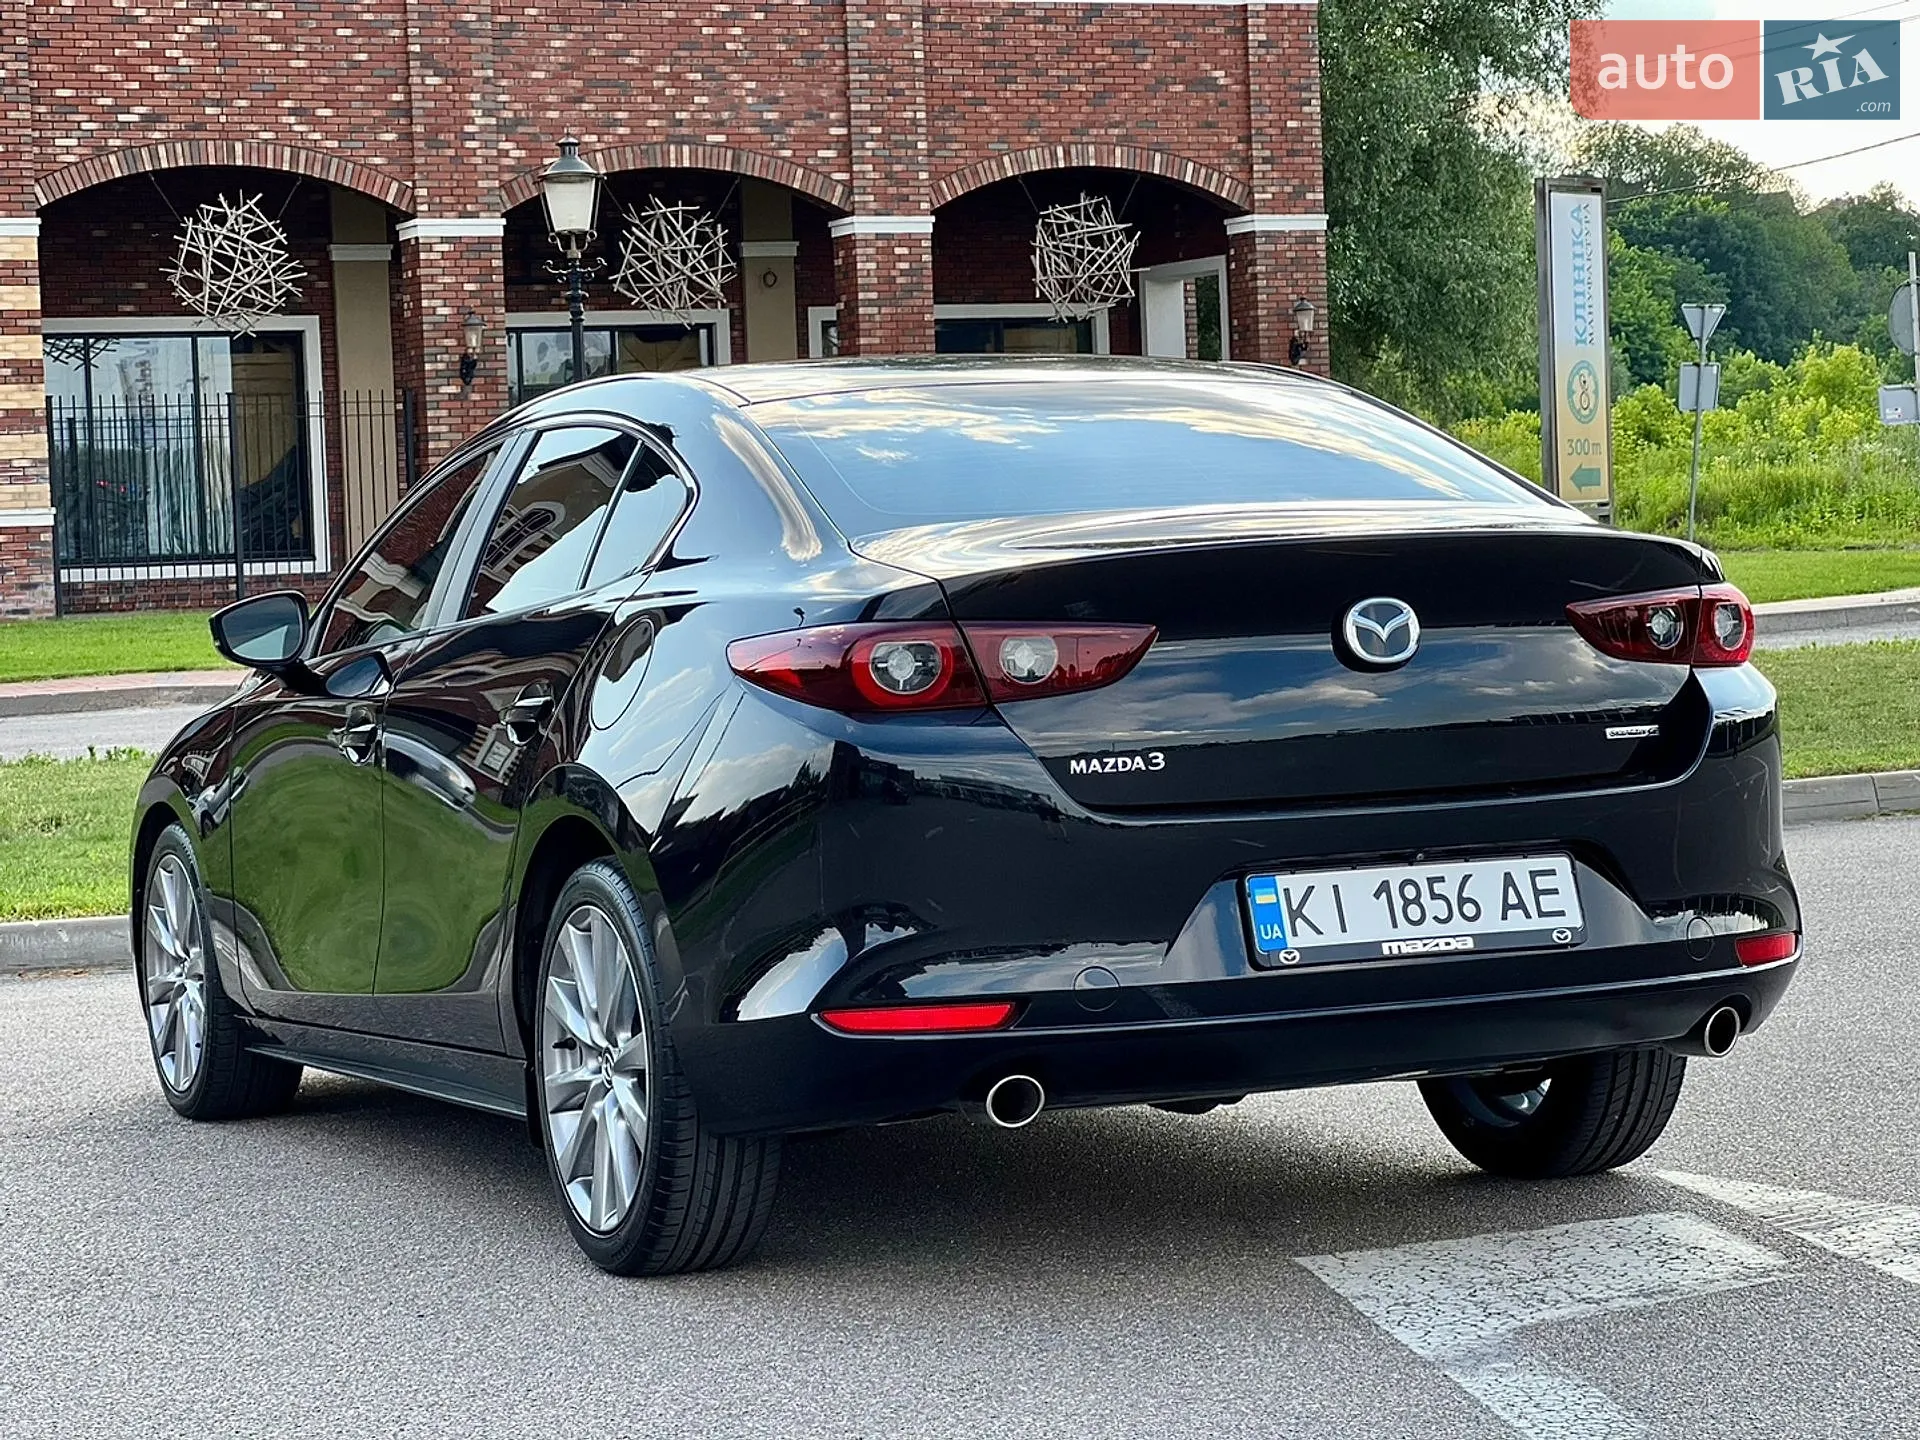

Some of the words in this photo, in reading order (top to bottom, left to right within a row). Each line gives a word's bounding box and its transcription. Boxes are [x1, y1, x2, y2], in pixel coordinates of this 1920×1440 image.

[1570, 204, 1588, 346] КЛІНІКА
[1283, 884, 1349, 938] KI
[1373, 874, 1482, 930] 1856
[1500, 868, 1567, 921] AE
[1260, 923, 1284, 940] UA
[1381, 936, 1474, 956] mazda
